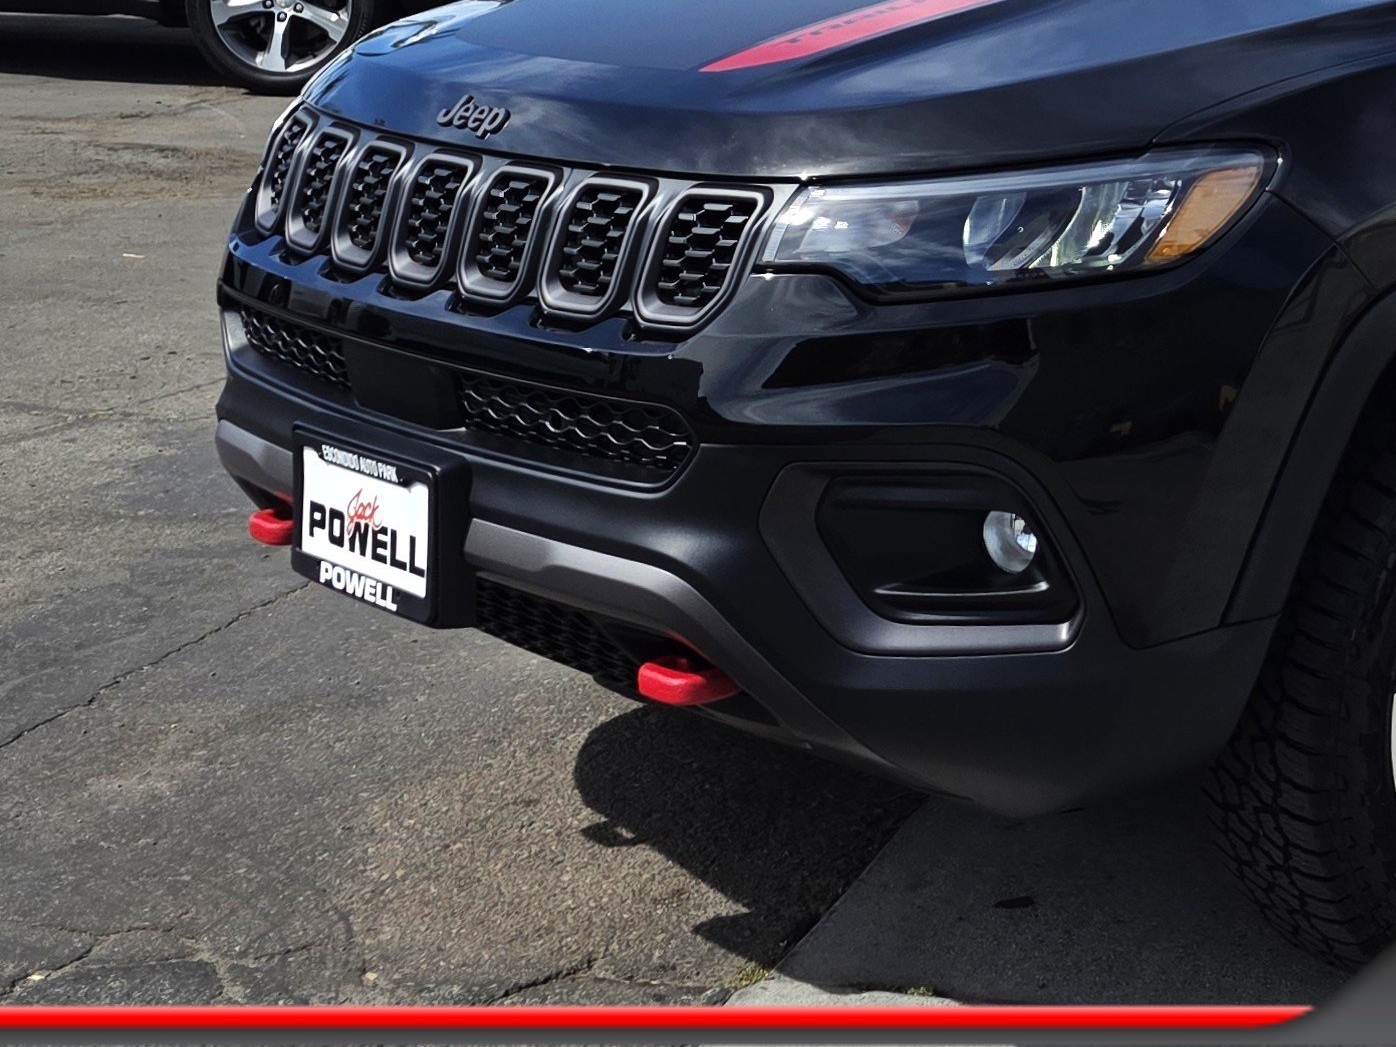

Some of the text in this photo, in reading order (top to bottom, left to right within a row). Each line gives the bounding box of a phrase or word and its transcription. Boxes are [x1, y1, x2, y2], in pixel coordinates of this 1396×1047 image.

[436, 94, 510, 139] Jeep
[360, 456, 378, 477] AUTO
[378, 462, 399, 483] PARK
[347, 488, 382, 535] Jack
[309, 500, 425, 578] POWELL
[320, 561, 398, 611] POWELL
